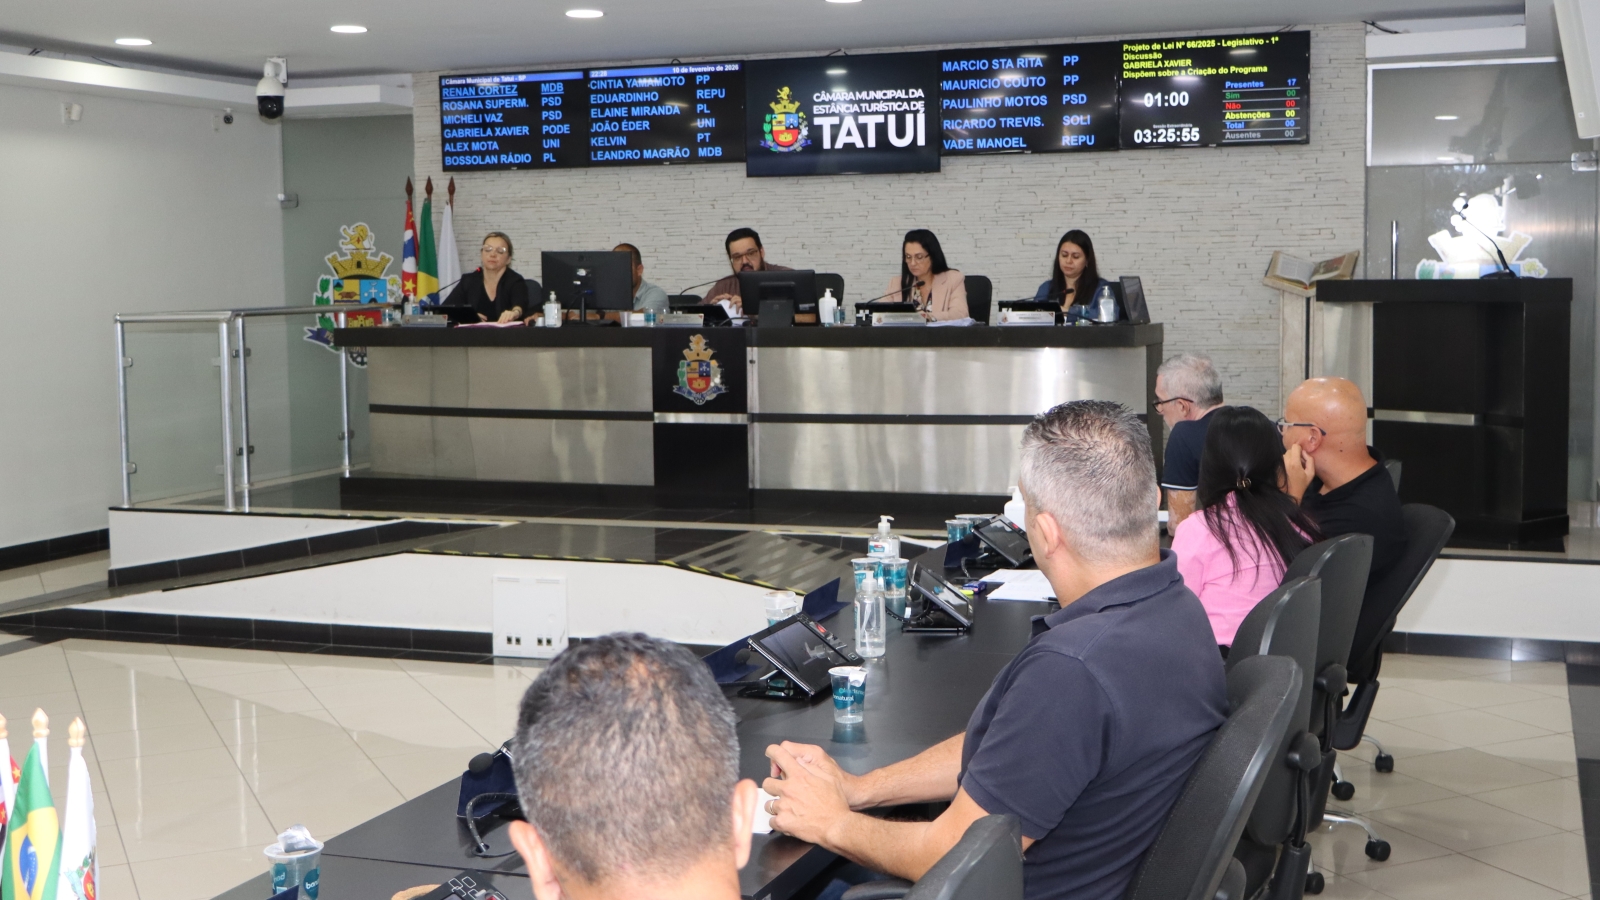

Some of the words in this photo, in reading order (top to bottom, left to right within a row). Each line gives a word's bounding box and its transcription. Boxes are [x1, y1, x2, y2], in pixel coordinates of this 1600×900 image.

[1123, 44, 1150, 52] Projeto
[1152, 42, 1161, 50] de
[1187, 40, 1216, 48] 66/2025
[1222, 38, 1264, 47] Legislativo
[1063, 56, 1079, 66] PP
[1123, 52, 1162, 60] Discussão
[943, 60, 988, 72] MARCIO
[992, 59, 1014, 70] STA
[1016, 57, 1043, 68] RITA
[1123, 60, 1162, 69] GABRIELA
[1164, 59, 1192, 67] XAVIER
[1158, 69, 1179, 77] sobre
[1187, 67, 1216, 76] Criação
[1218, 66, 1228, 74] do
[1230, 66, 1268, 74] Programa
[590, 79, 624, 89] CINTIA
[625, 76, 685, 88] YAMAMOTO
[696, 75, 710, 84] PP
[943, 79, 1000, 90] MAURICIO
[1004, 76, 1046, 88] COUTO
[1063, 75, 1079, 85] PP
[1225, 81, 1264, 89] Presentes
[1287, 78, 1297, 86] 17
[442, 86, 476, 97] RENAN
[478, 84, 518, 95] CORTEZ
[541, 82, 564, 92] MDB
[590, 92, 659, 104] EDUARDINHO
[696, 89, 725, 99] REPU
[813, 91, 855, 102] CÂMARA
[856, 89, 908, 100] MUNICIPAL
[909, 89, 924, 98] DA
[1144, 90, 1189, 107] 01:00
[1286, 89, 1296, 97] 00
[443, 100, 483, 111] ROSANA
[485, 98, 529, 109] SUPERM.
[542, 96, 562, 106] PSD
[943, 96, 1001, 109] PAULINHO
[1004, 96, 1047, 107] MOTOS
[1062, 94, 1087, 105] PSD
[591, 107, 628, 118] ELAINE
[631, 105, 680, 116] MIRANDA
[697, 104, 710, 113] PL
[813, 103, 860, 114] ESTÂNCIA
[860, 101, 910, 112] TURÍSTICA
[910, 101, 925, 110] DE
[1225, 102, 1241, 110] Não
[443, 113, 482, 124] MICHELI
[485, 113, 503, 122] VAZ
[542, 110, 562, 120] PSD
[1225, 111, 1271, 120] Abstenções
[1285, 110, 1296, 118] 00
[591, 121, 619, 132] JOÃO
[622, 119, 650, 131] ÉDER
[697, 118, 715, 128] UNI
[943, 118, 996, 130] RICARDO
[1000, 116, 1044, 128] TREVIS.
[1063, 115, 1091, 126] SOLI
[1225, 121, 1245, 129] Total
[444, 127, 493, 138] GABRIELA
[495, 126, 529, 136] XAVIER
[542, 124, 570, 134] PODE
[814, 109, 925, 149] TATUÍ
[697, 133, 711, 142] PT
[1062, 135, 1095, 146] REPU
[1134, 127, 1200, 143] 03:25:55
[1225, 131, 1261, 139] Ausentes
[444, 142, 469, 152] ALEX
[472, 141, 499, 151] MOTA
[543, 139, 560, 148] UNI
[591, 136, 626, 146] KELVIN
[943, 139, 974, 149] VADE
[977, 137, 1027, 149] MANOEL
[544, 153, 556, 162] PL
[591, 150, 640, 161] LEANDRO
[643, 146, 690, 159] MAGRÃO
[698, 147, 722, 157] MDB
[445, 155, 498, 166] BOSSOLAN
[500, 152, 532, 164] RÁDIO
